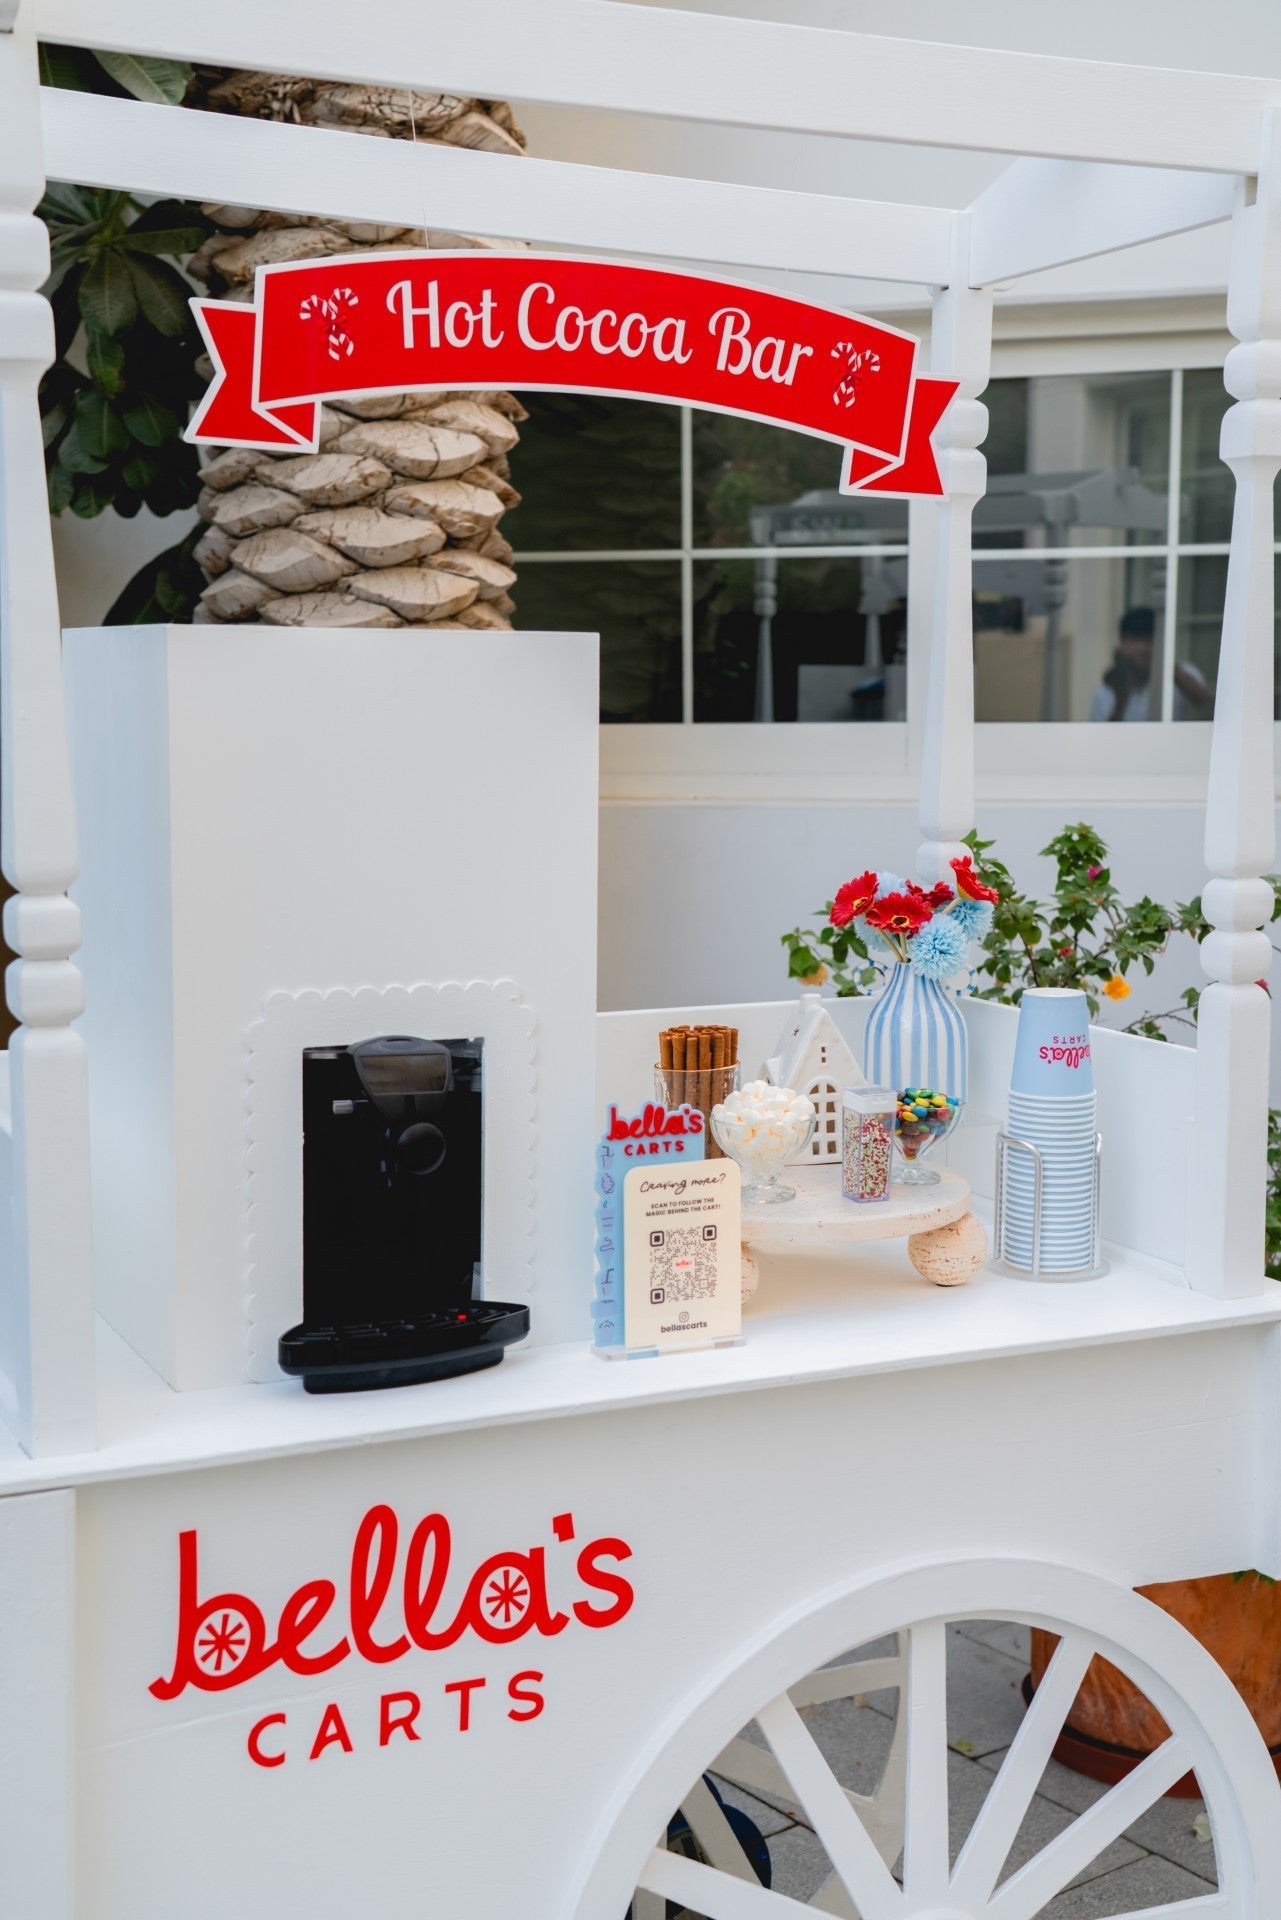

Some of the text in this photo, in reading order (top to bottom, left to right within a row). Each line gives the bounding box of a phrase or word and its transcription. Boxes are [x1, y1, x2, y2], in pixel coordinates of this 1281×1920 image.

[386, 280, 813, 386] Hot Cocoa Bar
[1053, 1034, 1086, 1044] CARTS
[606, 1103, 703, 1141] bella's
[624, 1140, 685, 1157] CARTS
[639, 1173, 726, 1195] Craving more?
[660, 1321, 708, 1333] bellascarts
[148, 1504, 635, 1701] bella's
[247, 1670, 545, 1768] CARTS
